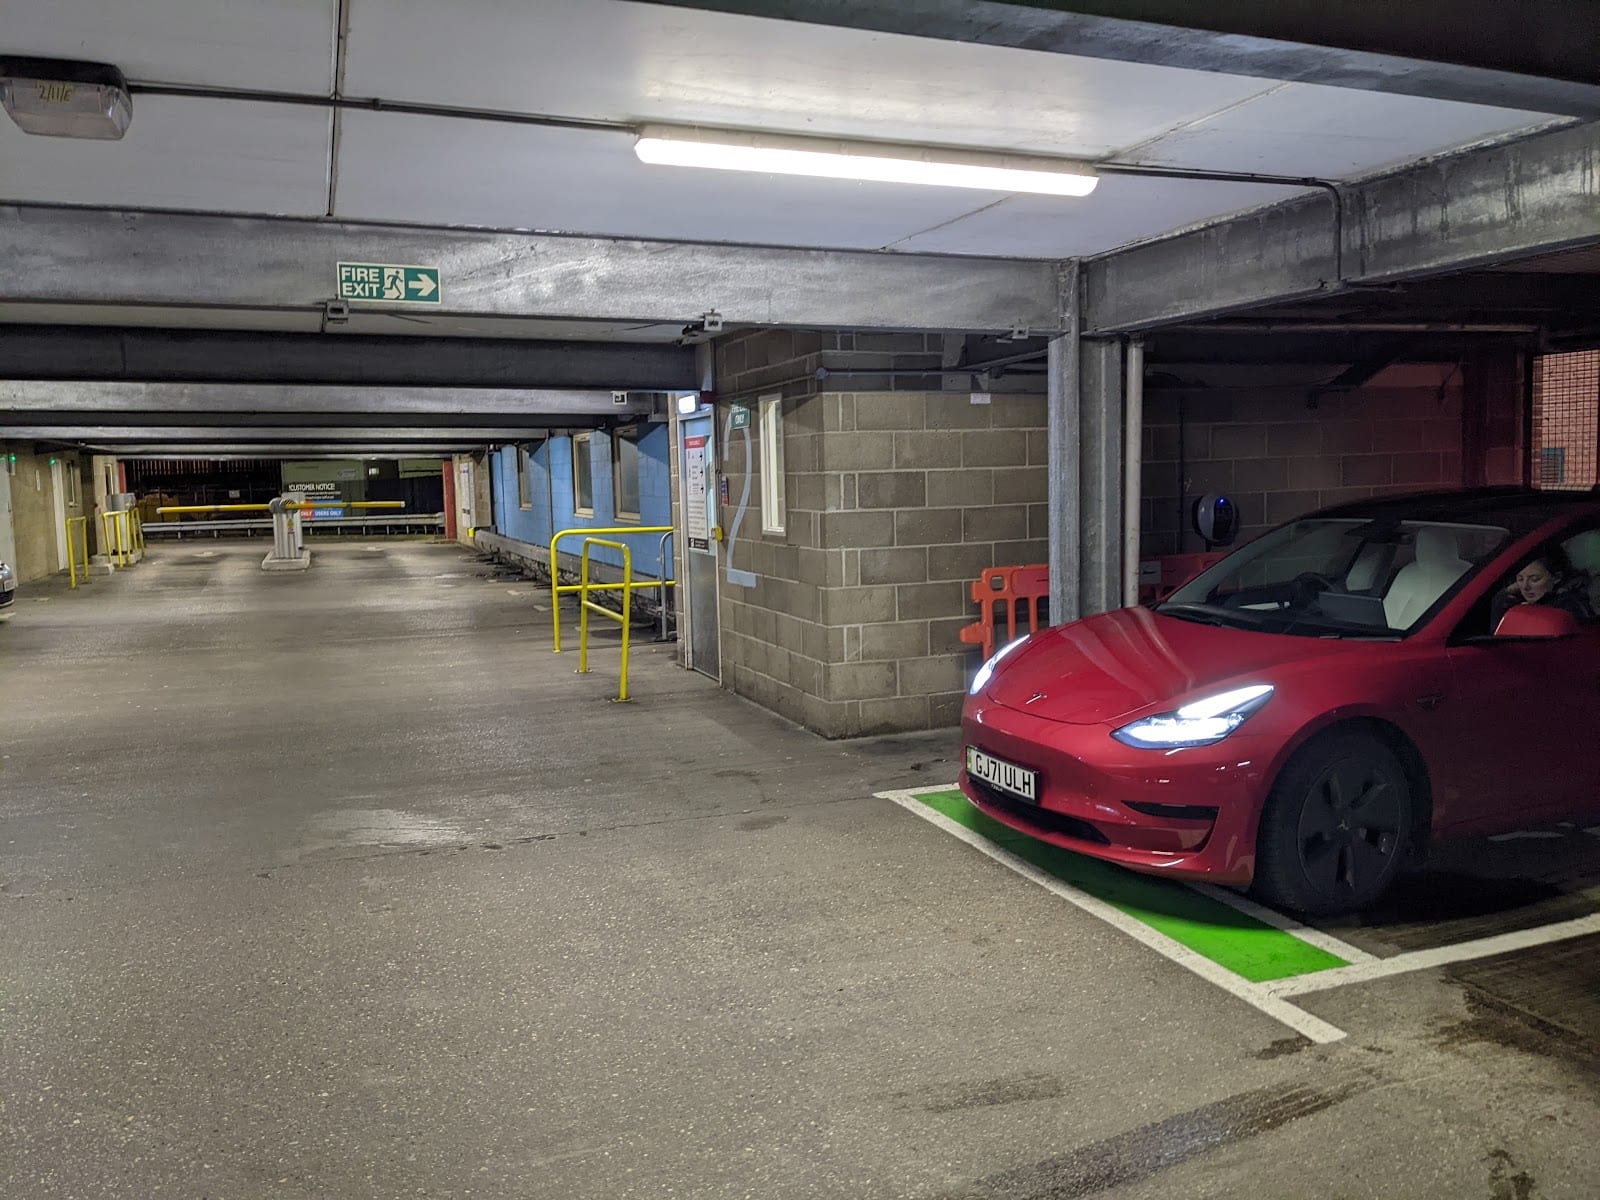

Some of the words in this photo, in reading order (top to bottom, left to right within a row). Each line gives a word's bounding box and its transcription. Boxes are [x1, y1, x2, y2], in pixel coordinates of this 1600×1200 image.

[341, 266, 380, 282] FIRE
[342, 282, 380, 297] EXIT
[975, 753, 1001, 784] GJ71
[1004, 764, 1031, 796] ULH
